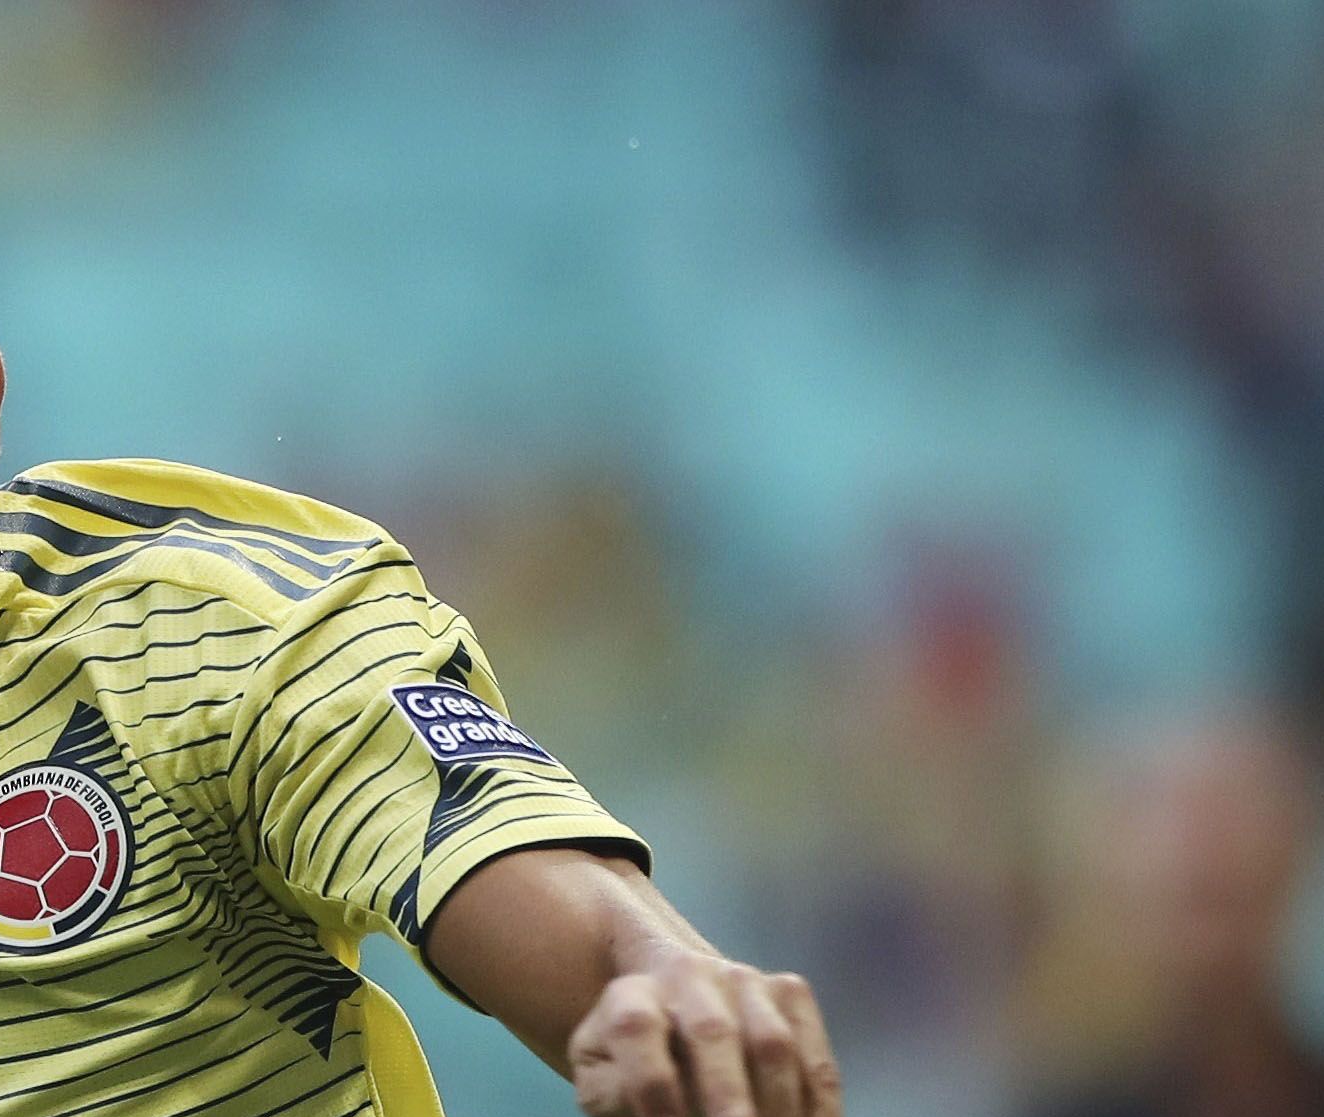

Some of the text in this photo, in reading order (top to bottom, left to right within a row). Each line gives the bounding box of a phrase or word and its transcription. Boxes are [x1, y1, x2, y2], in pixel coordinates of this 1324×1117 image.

[406, 692, 483, 719] Cree
[429, 721, 536, 752] grande
[63, 775, 82, 794] DE
[78, 783, 116, 830] FUTBOL
